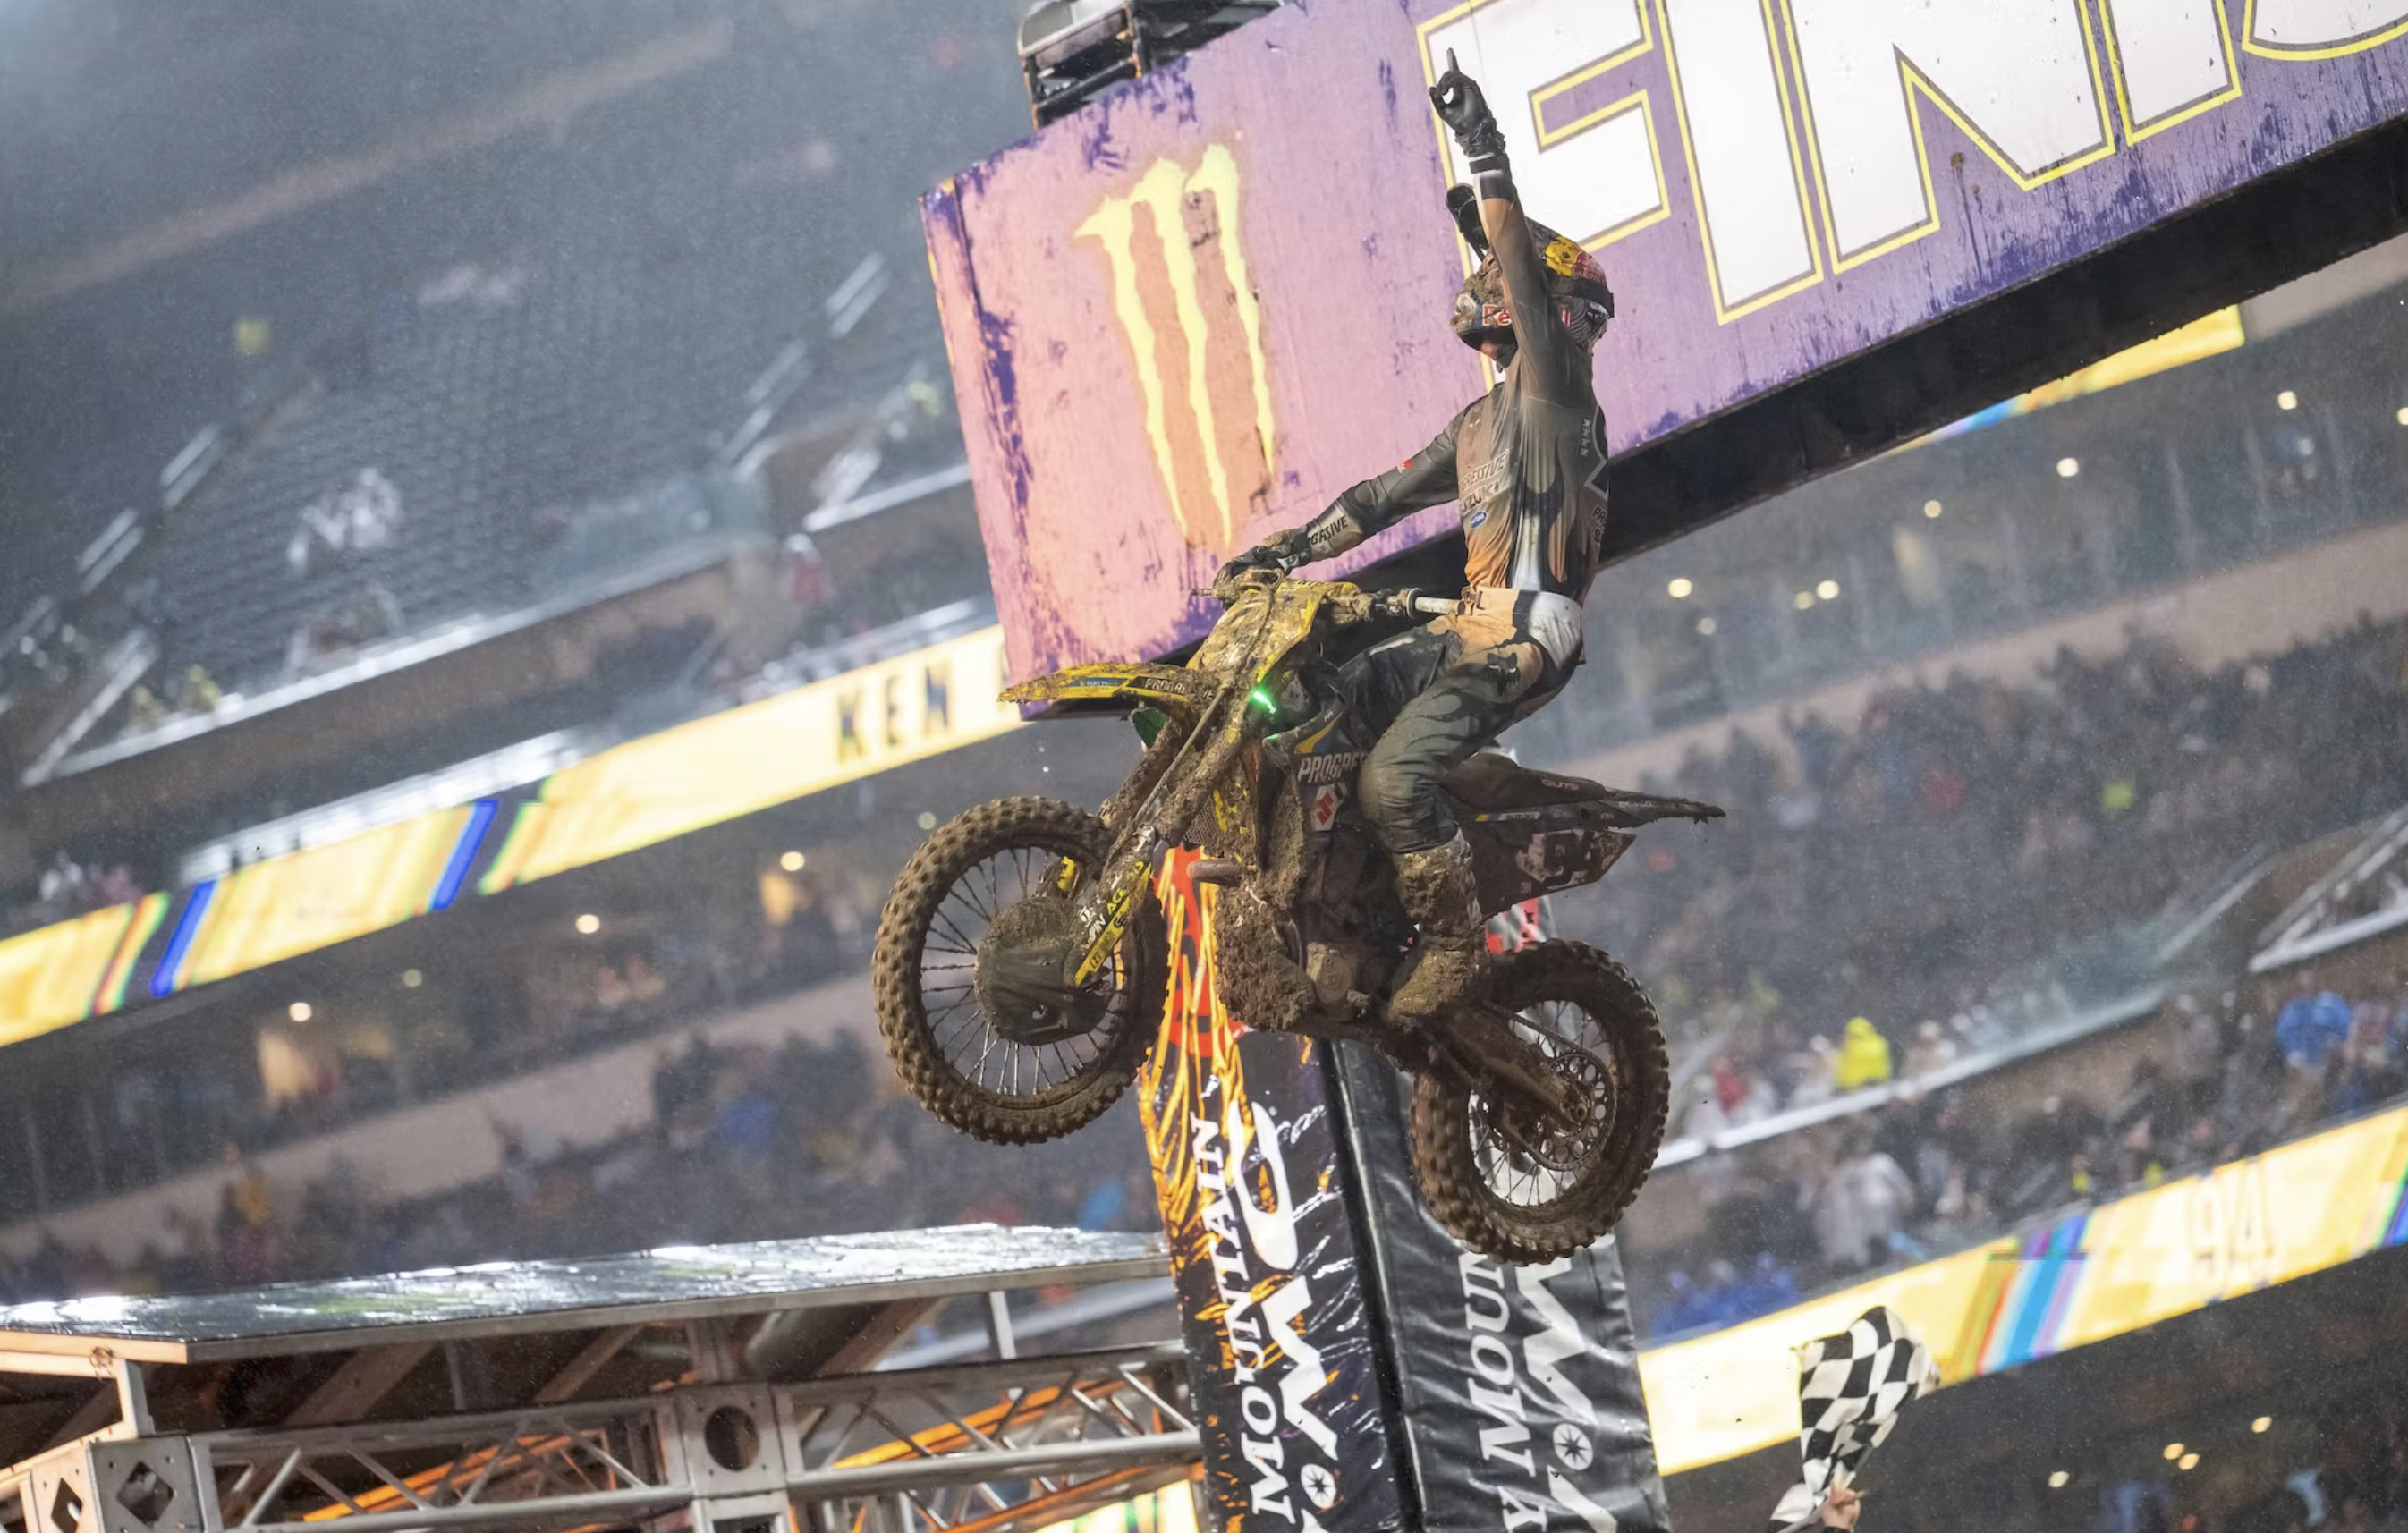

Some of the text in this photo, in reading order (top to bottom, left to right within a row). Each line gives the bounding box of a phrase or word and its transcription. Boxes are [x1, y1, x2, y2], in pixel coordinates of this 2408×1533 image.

[1417, 0, 2408, 392] FIN
[1482, 304, 1513, 326] Re
[835, 657, 957, 767] KEN
[1189, 1110, 1296, 1525] MOUNTAIN
[1458, 1252, 1536, 1478] MOUN
